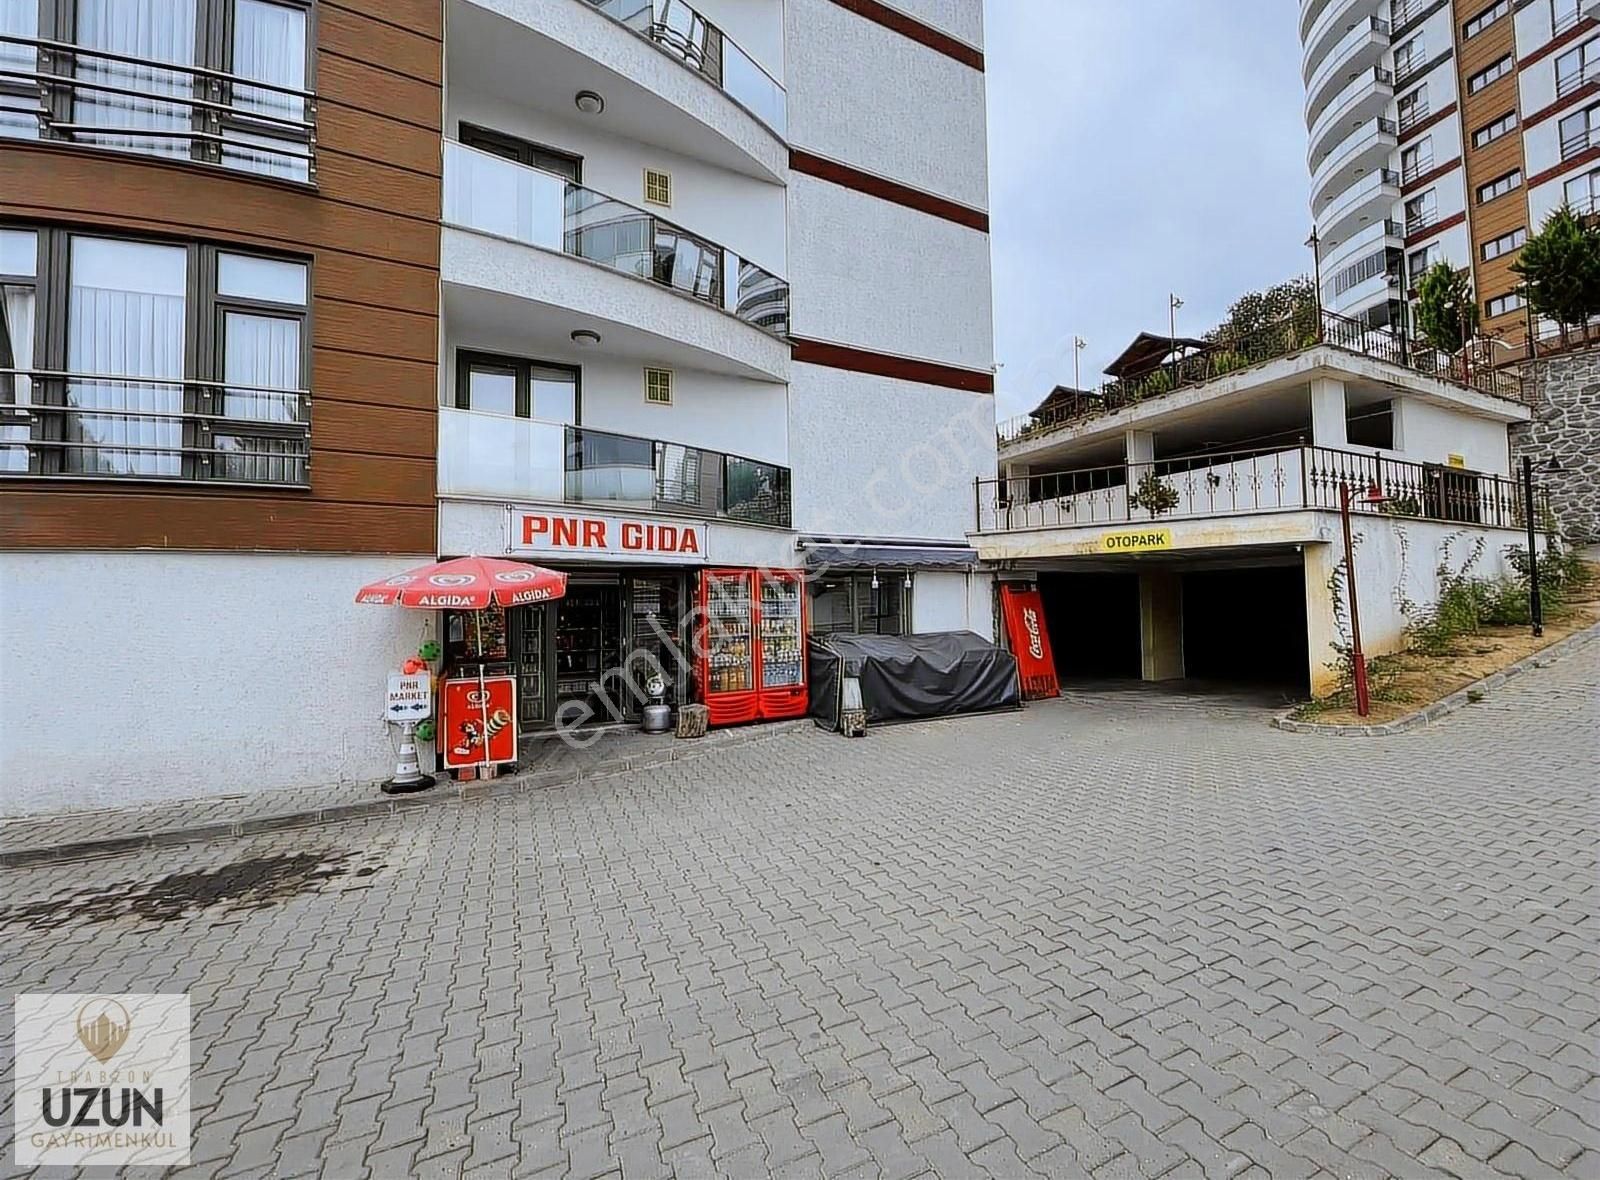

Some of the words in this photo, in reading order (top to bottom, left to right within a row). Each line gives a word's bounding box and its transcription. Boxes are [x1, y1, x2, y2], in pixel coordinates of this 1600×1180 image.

[522, 515, 607, 549] PNR
[621, 523, 699, 553] GIDA
[1106, 533, 1165, 548] OTOPARK
[419, 594, 471, 606] ALGIDA
[512, 587, 549, 603] ALGIDA
[400, 681, 419, 690] PNR
[389, 691, 428, 701] MARKET
